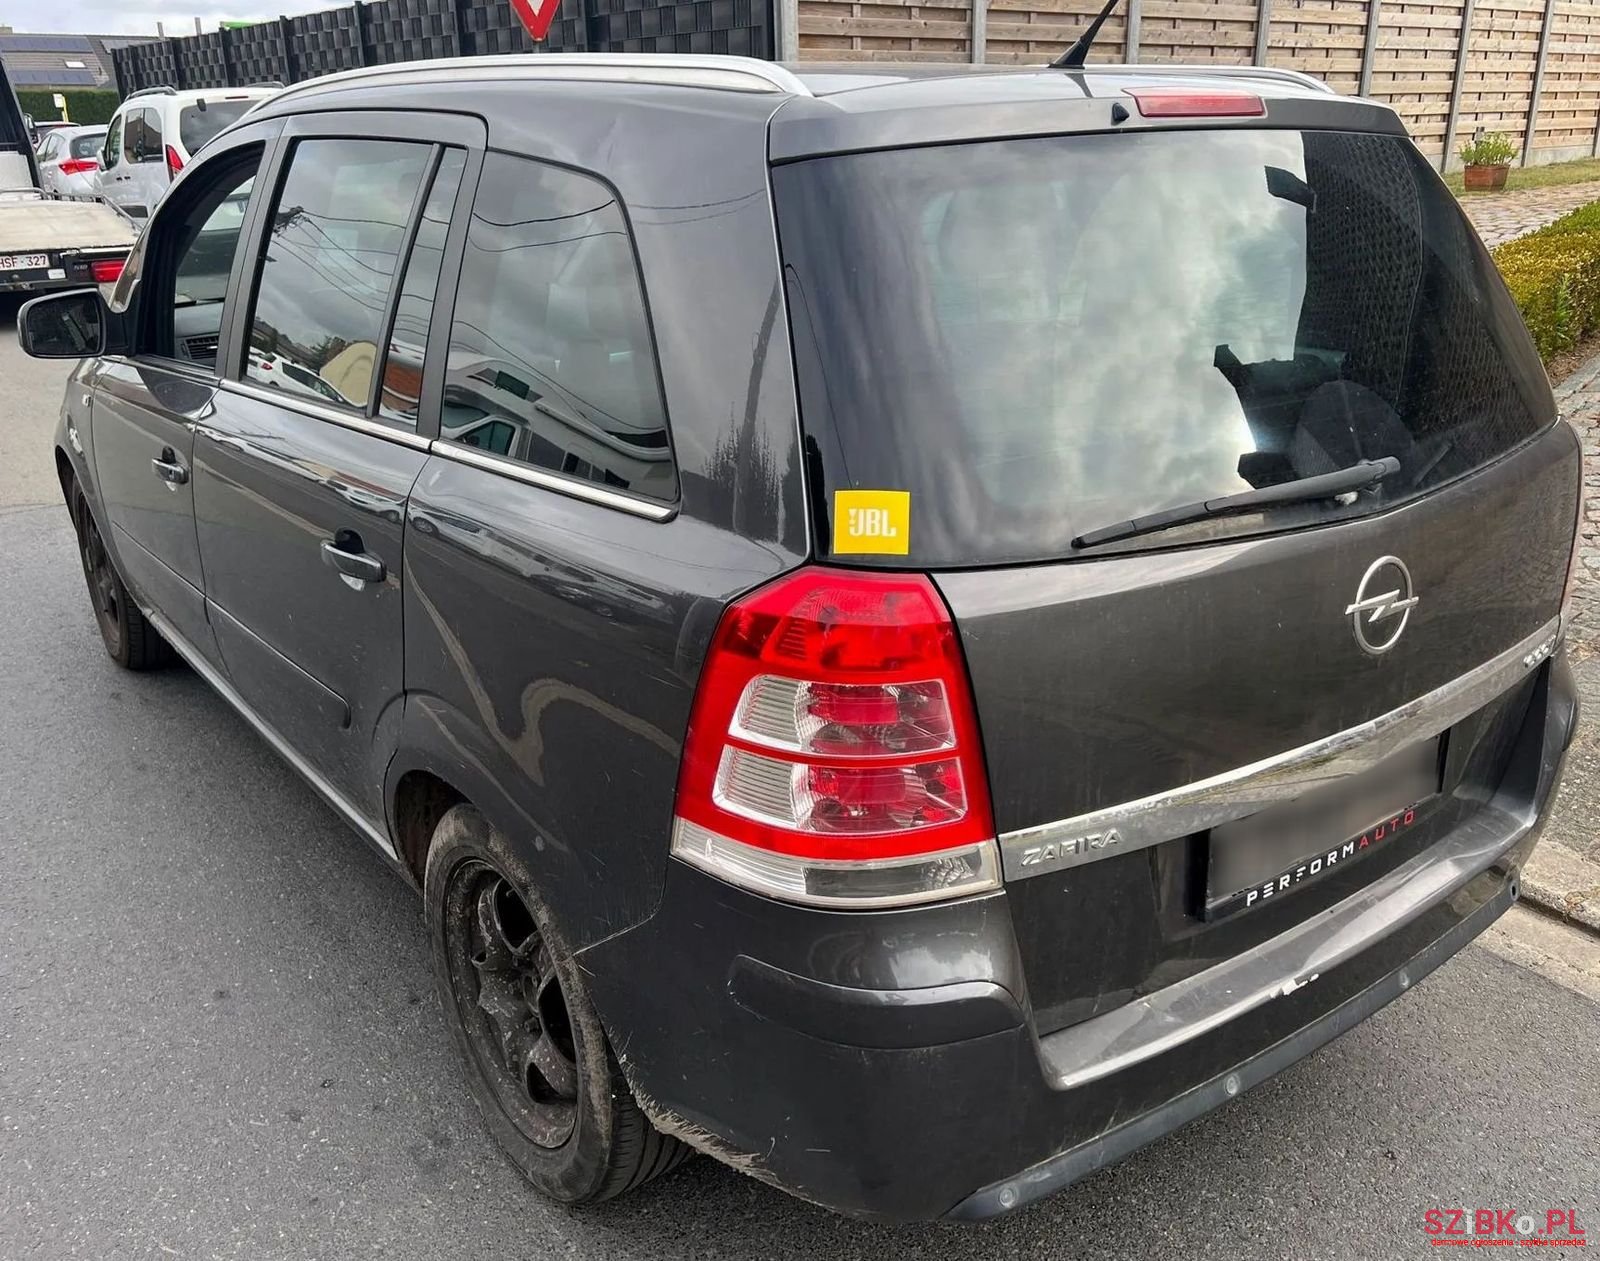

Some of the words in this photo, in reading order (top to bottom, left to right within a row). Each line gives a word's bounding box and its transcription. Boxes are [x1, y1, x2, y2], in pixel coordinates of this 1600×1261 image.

[25, 255, 46, 267] 327
[848, 507, 897, 538] JBL
[1020, 828, 1124, 867] ZAFIRA
